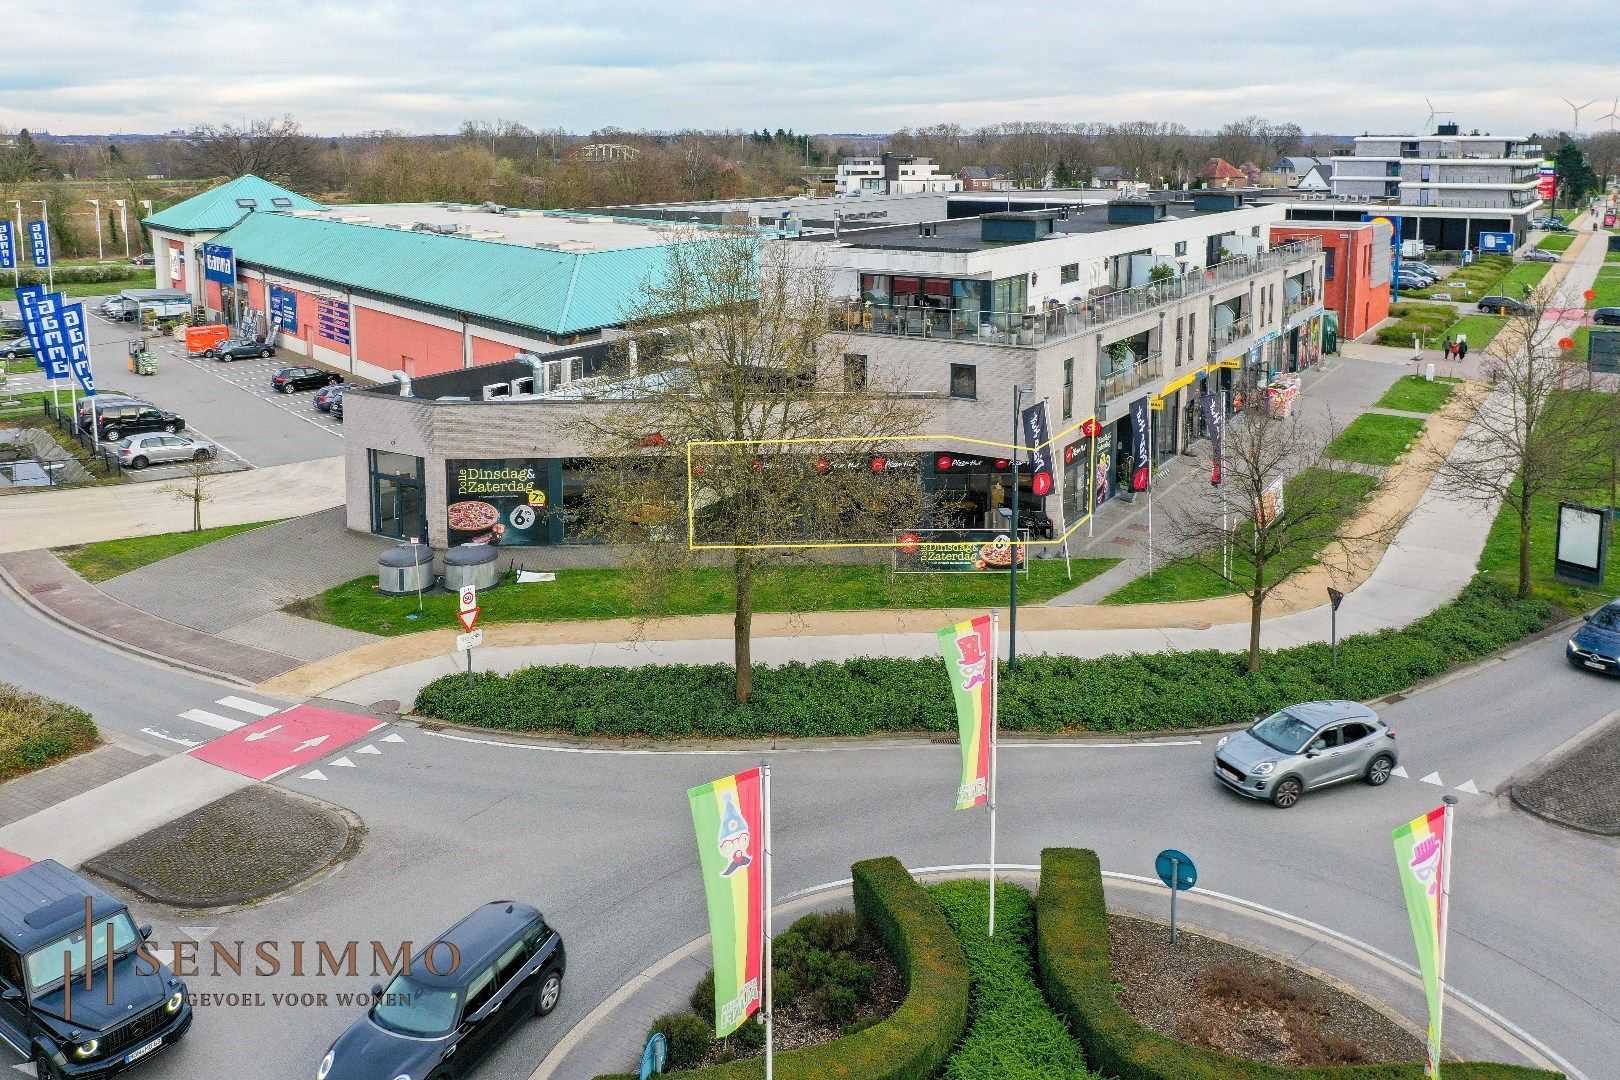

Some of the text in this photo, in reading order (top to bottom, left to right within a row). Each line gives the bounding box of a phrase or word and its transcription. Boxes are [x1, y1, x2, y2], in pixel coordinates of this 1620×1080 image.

[458, 469, 467, 494] Dolle
[468, 481, 535, 494] Zaterdag
[928, 552, 978, 562] Zaterdag
